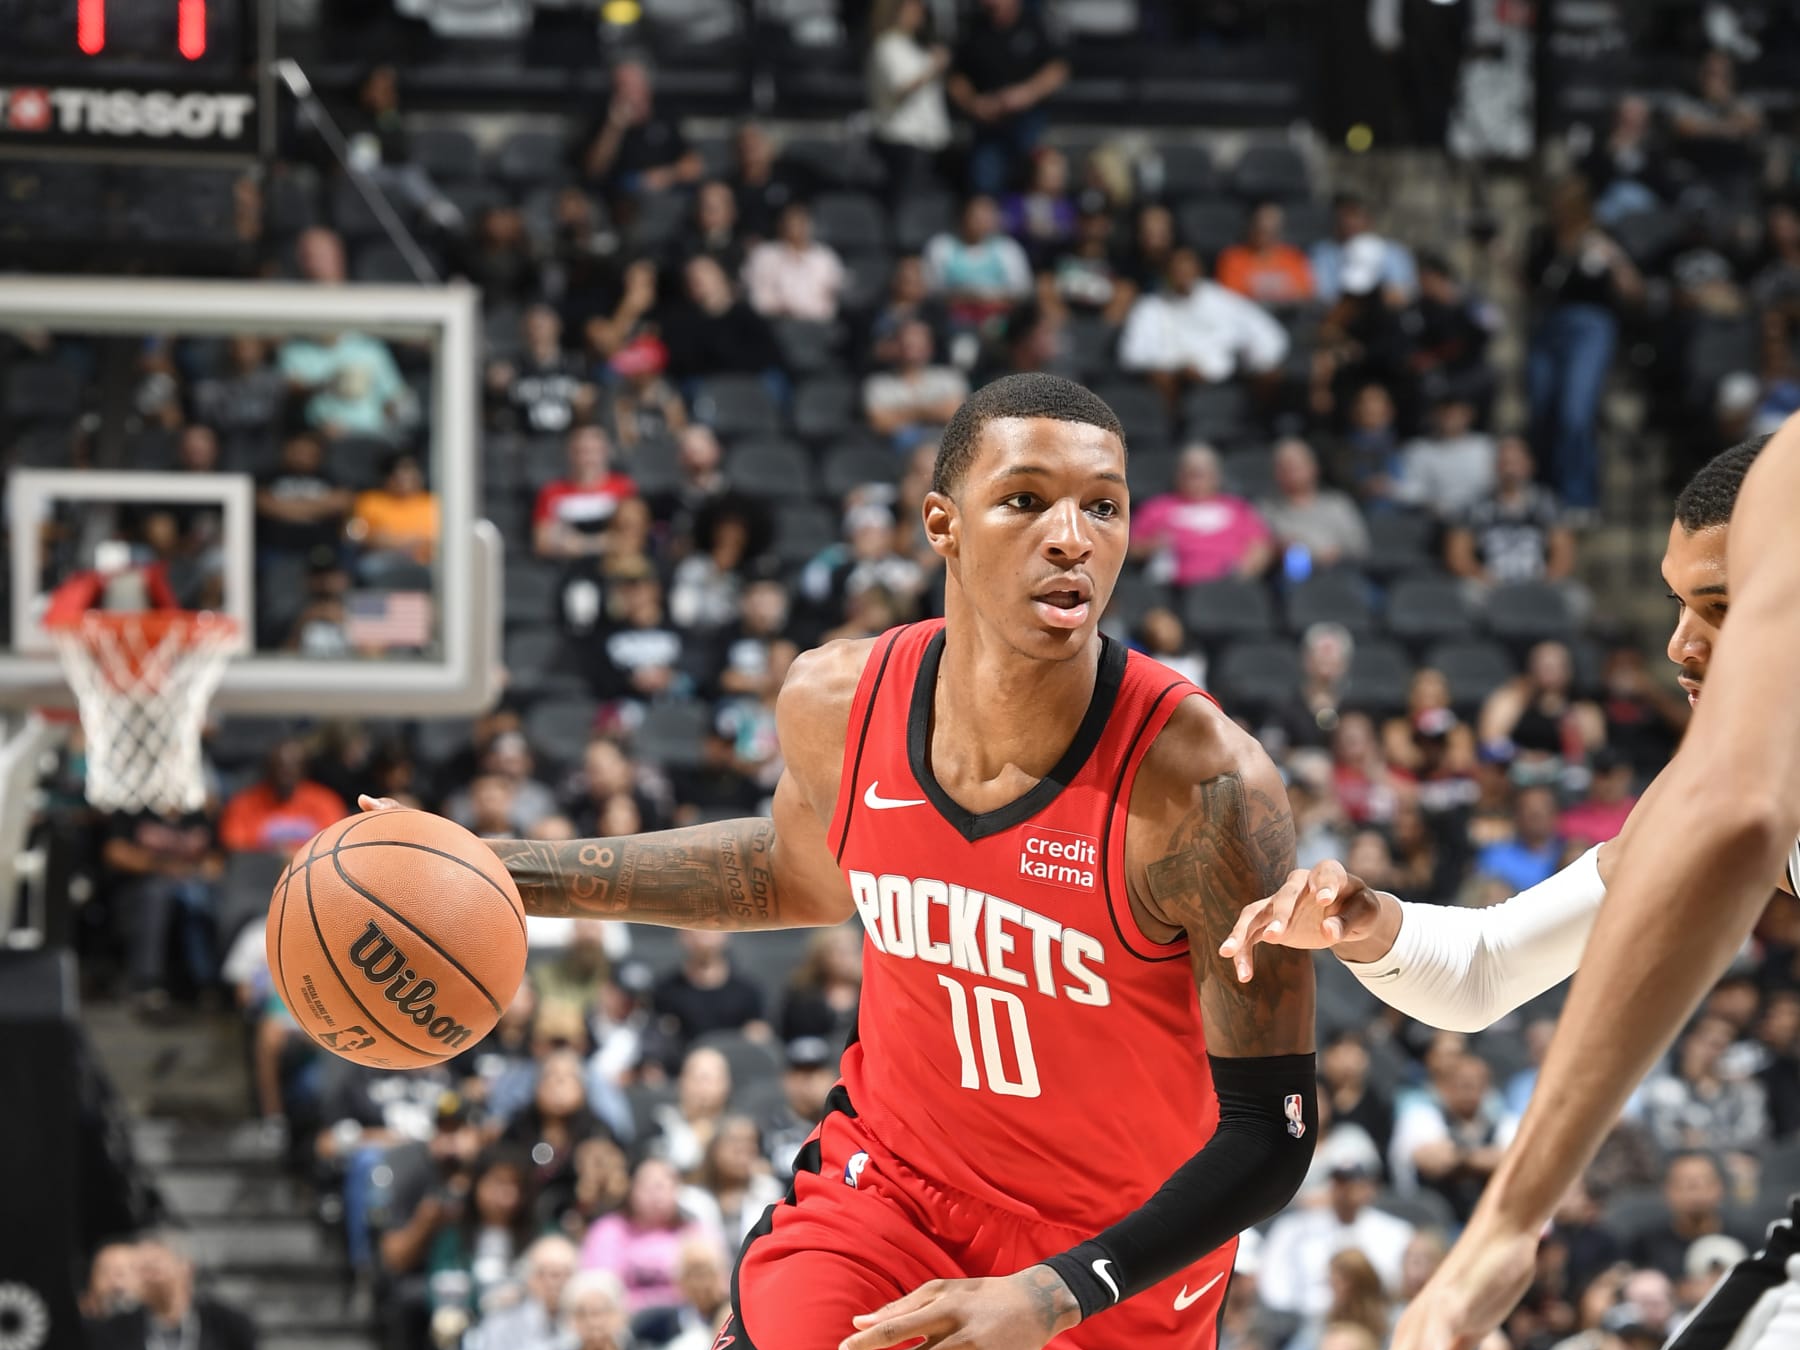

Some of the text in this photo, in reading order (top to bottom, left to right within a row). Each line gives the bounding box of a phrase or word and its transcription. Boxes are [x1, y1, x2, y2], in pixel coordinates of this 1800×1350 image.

[51, 87, 255, 139] TISSOT
[1020, 853, 1094, 888] karma
[1026, 838, 1096, 865] credit
[849, 869, 1111, 1008] ROCKETS
[350, 918, 473, 1049] Wilson
[936, 973, 1042, 1099] 10
